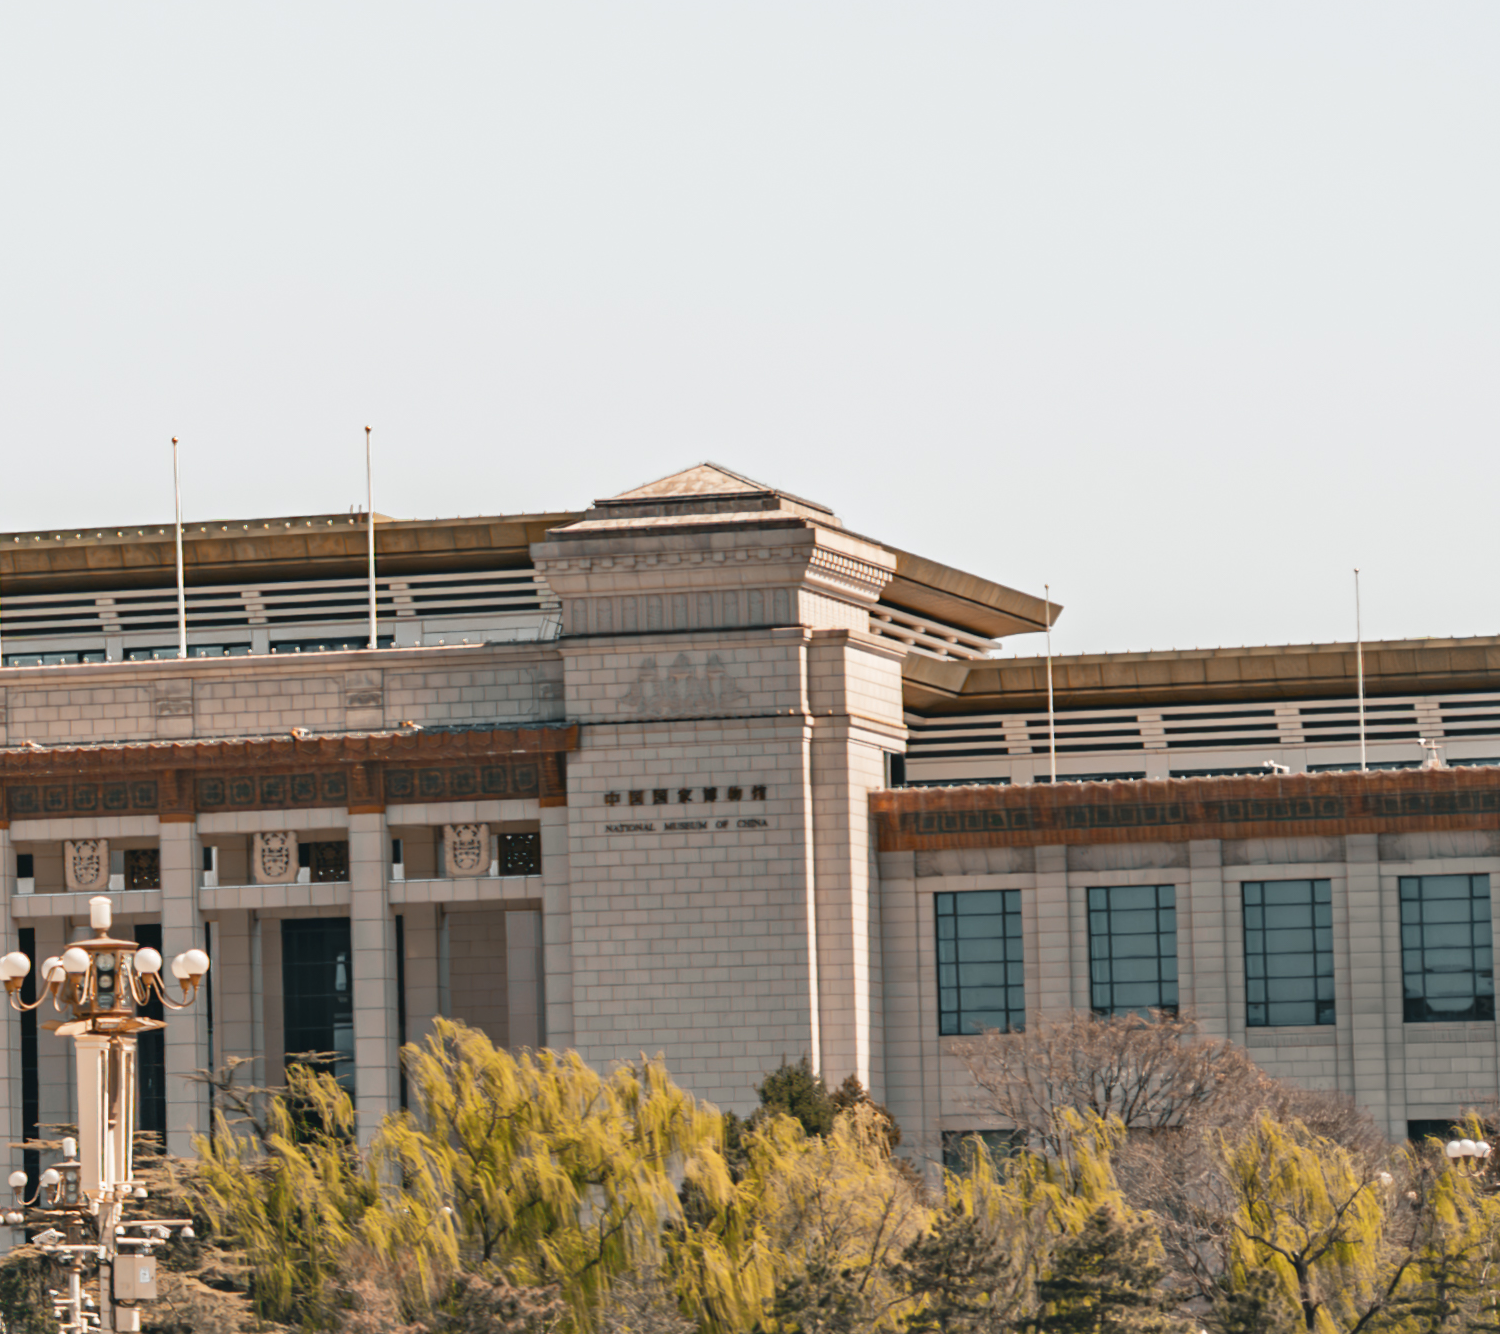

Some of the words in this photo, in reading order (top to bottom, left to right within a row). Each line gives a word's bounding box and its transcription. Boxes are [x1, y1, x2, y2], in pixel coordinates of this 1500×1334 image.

[605, 823, 656, 832] NATIONAL
[664, 821, 707, 830] MUSEUM
[716, 820, 728, 829] OF
[737, 819, 768, 828] CHINA
